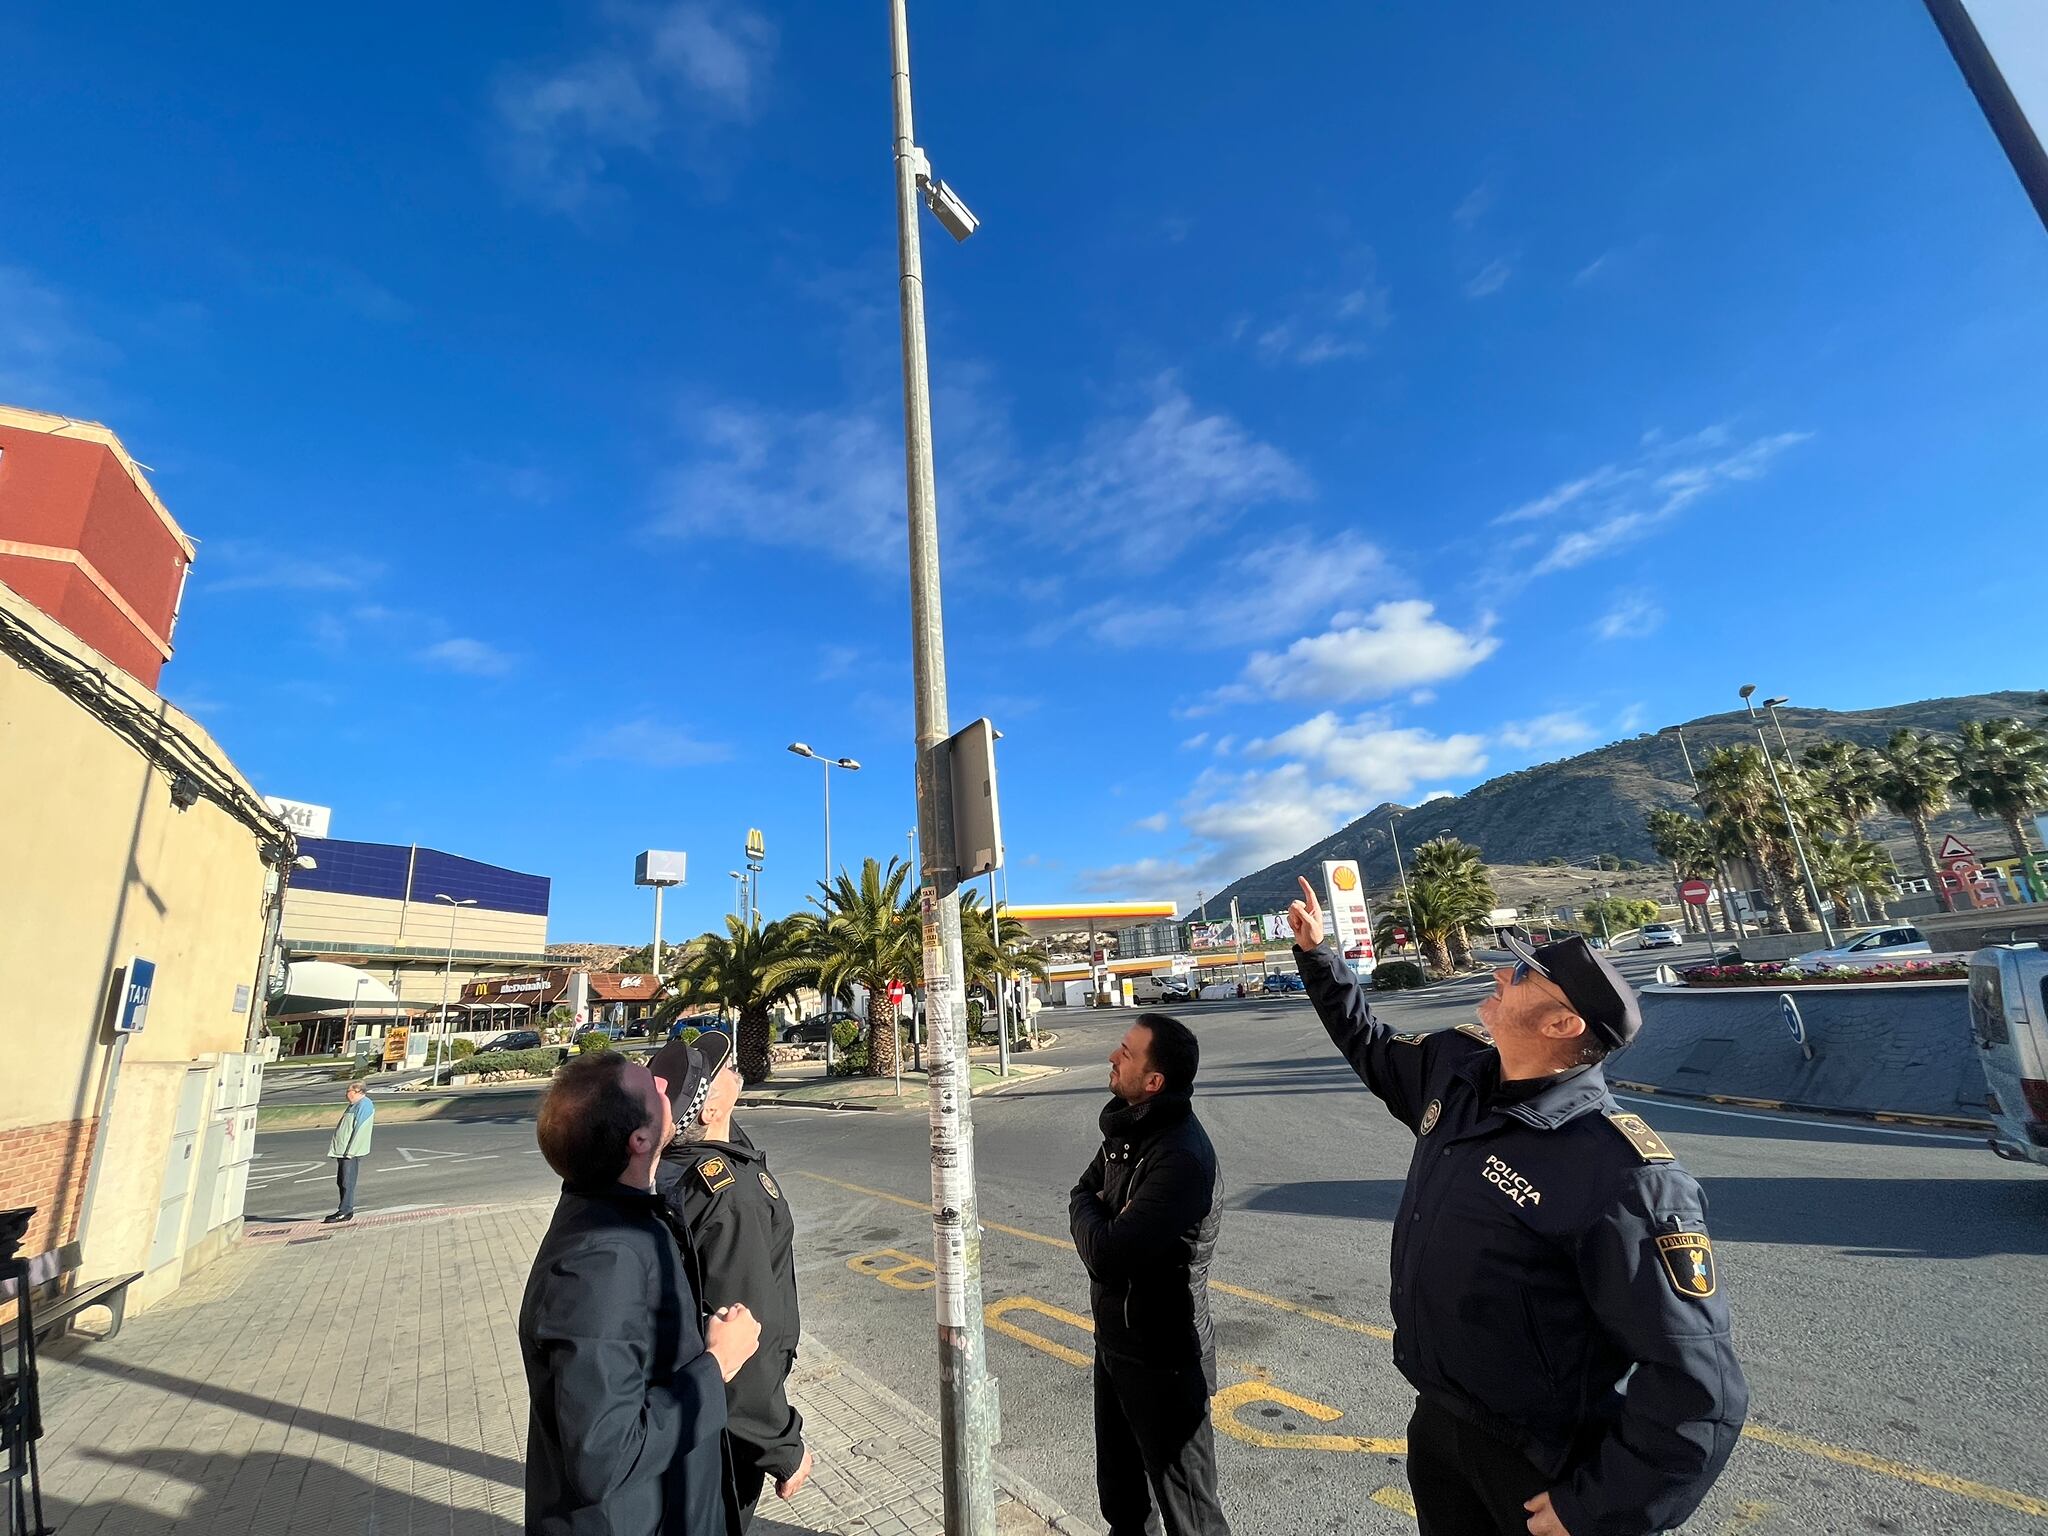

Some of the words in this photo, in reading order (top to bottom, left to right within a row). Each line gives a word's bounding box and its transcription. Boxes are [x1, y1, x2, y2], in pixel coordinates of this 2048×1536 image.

[280, 803, 313, 827] Xti
[129, 983, 151, 1005] TAXI
[1482, 1166, 1526, 1208] LOCAL
[1486, 1154, 1541, 1205] POLICIA
